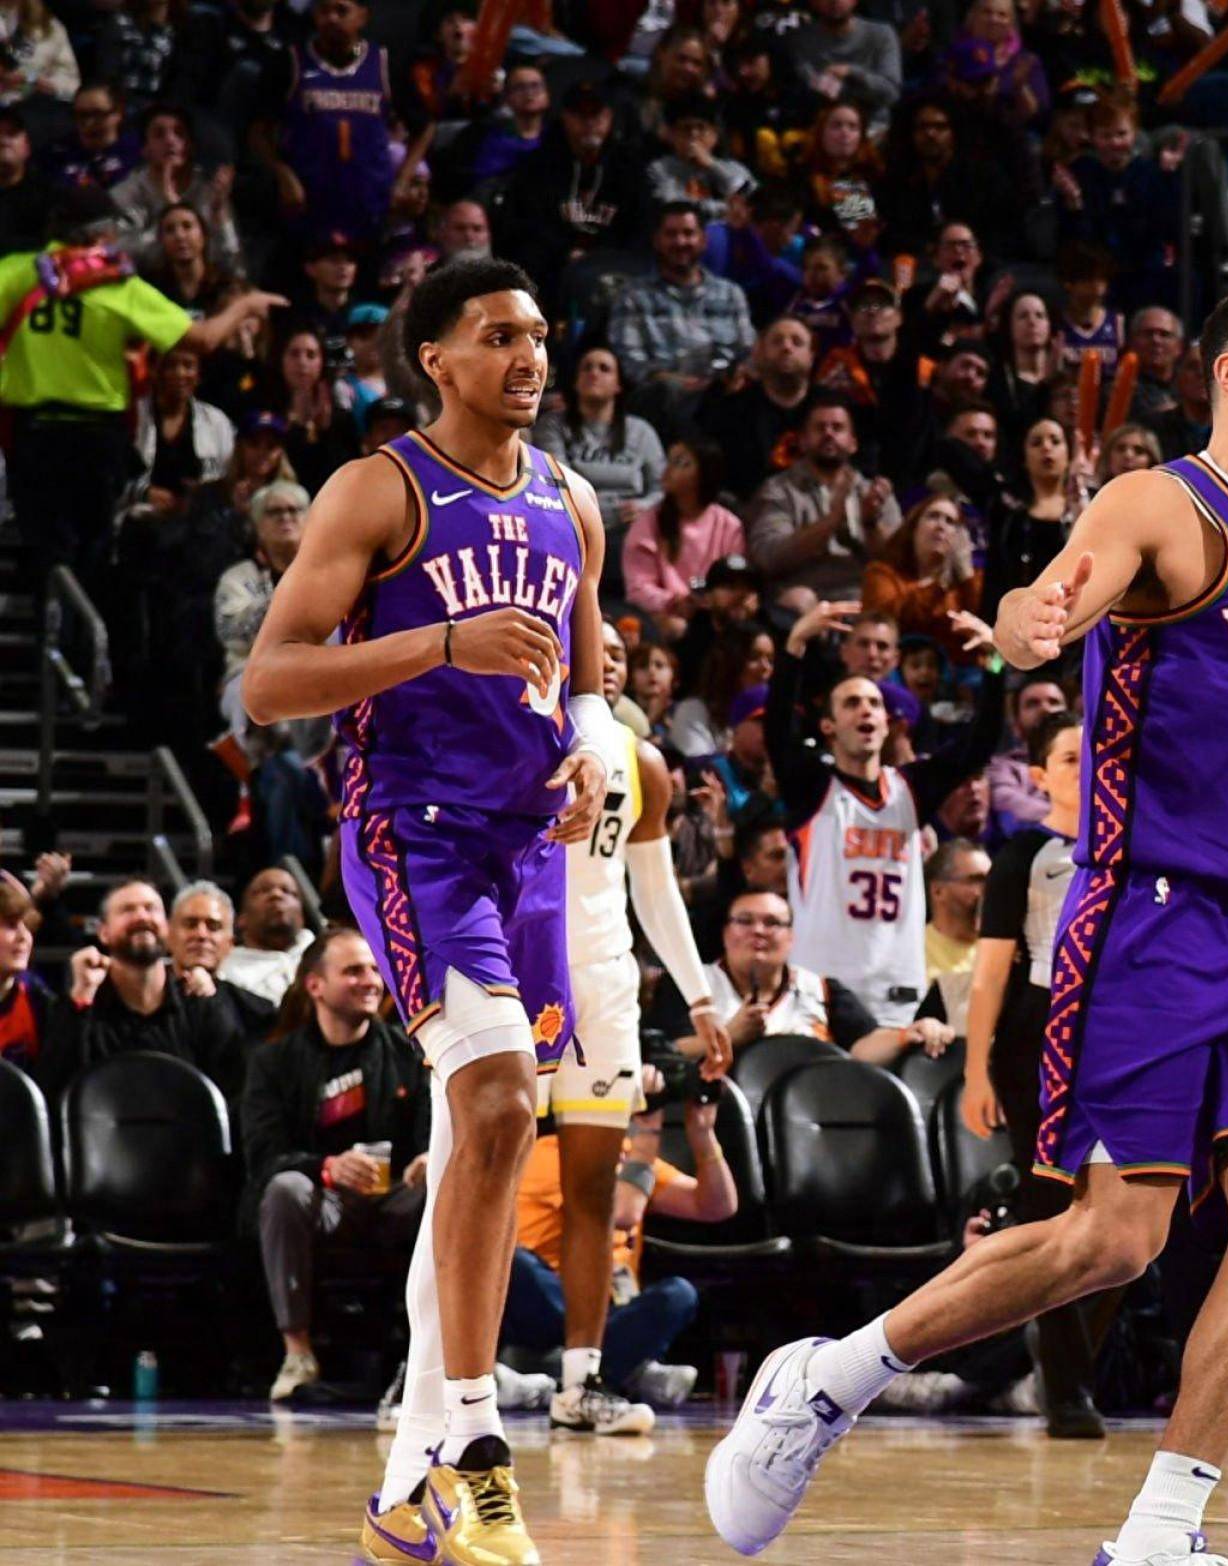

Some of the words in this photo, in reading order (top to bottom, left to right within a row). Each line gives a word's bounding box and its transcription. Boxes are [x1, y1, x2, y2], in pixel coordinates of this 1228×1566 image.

[337, 119, 351, 161] 1
[488, 513, 529, 542] THE
[589, 816, 623, 858] 13
[848, 870, 902, 922] 35
